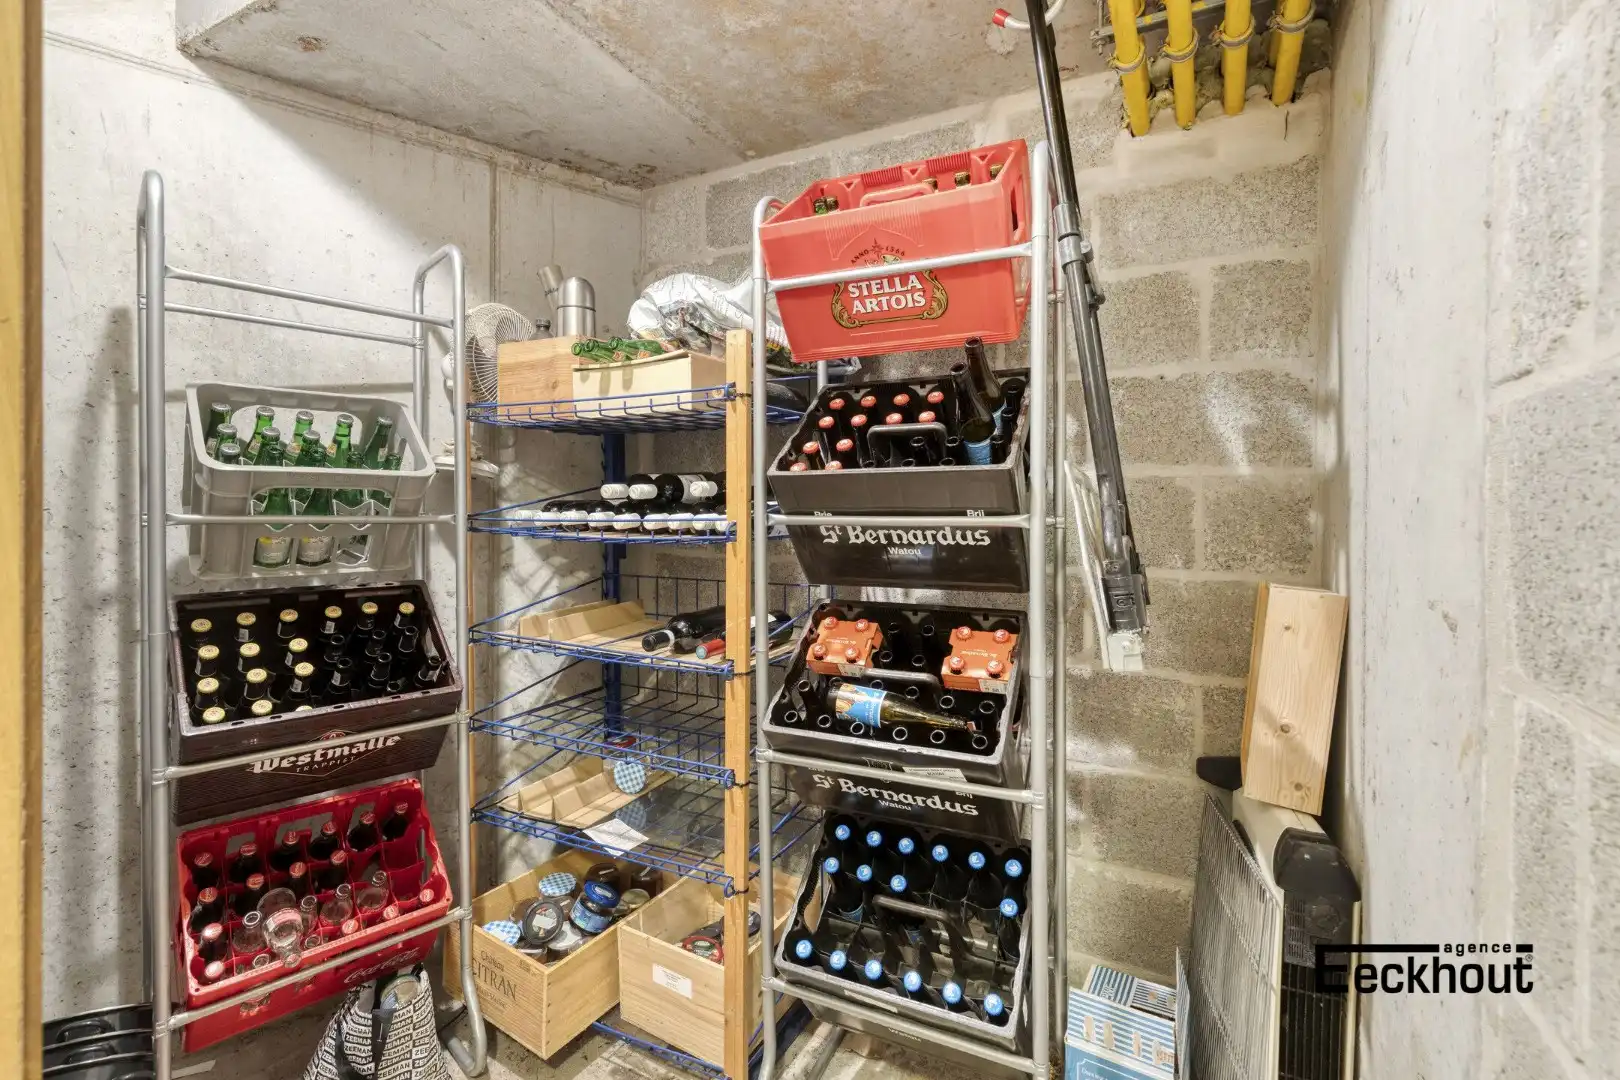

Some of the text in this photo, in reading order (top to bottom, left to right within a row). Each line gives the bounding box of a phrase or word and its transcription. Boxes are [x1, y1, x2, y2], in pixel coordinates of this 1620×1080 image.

[850, 249, 869, 264] ANNO
[847, 273, 923, 298] STELLA
[851, 290, 926, 315] ARTOIS
[819, 525, 991, 546] St Bernardus
[887, 546, 922, 556] Watou
[246, 734, 401, 774] Westmalle
[296, 755, 355, 773] TRAPPIST
[812, 773, 979, 816] St Bernardus
[878, 799, 912, 812] Watou
